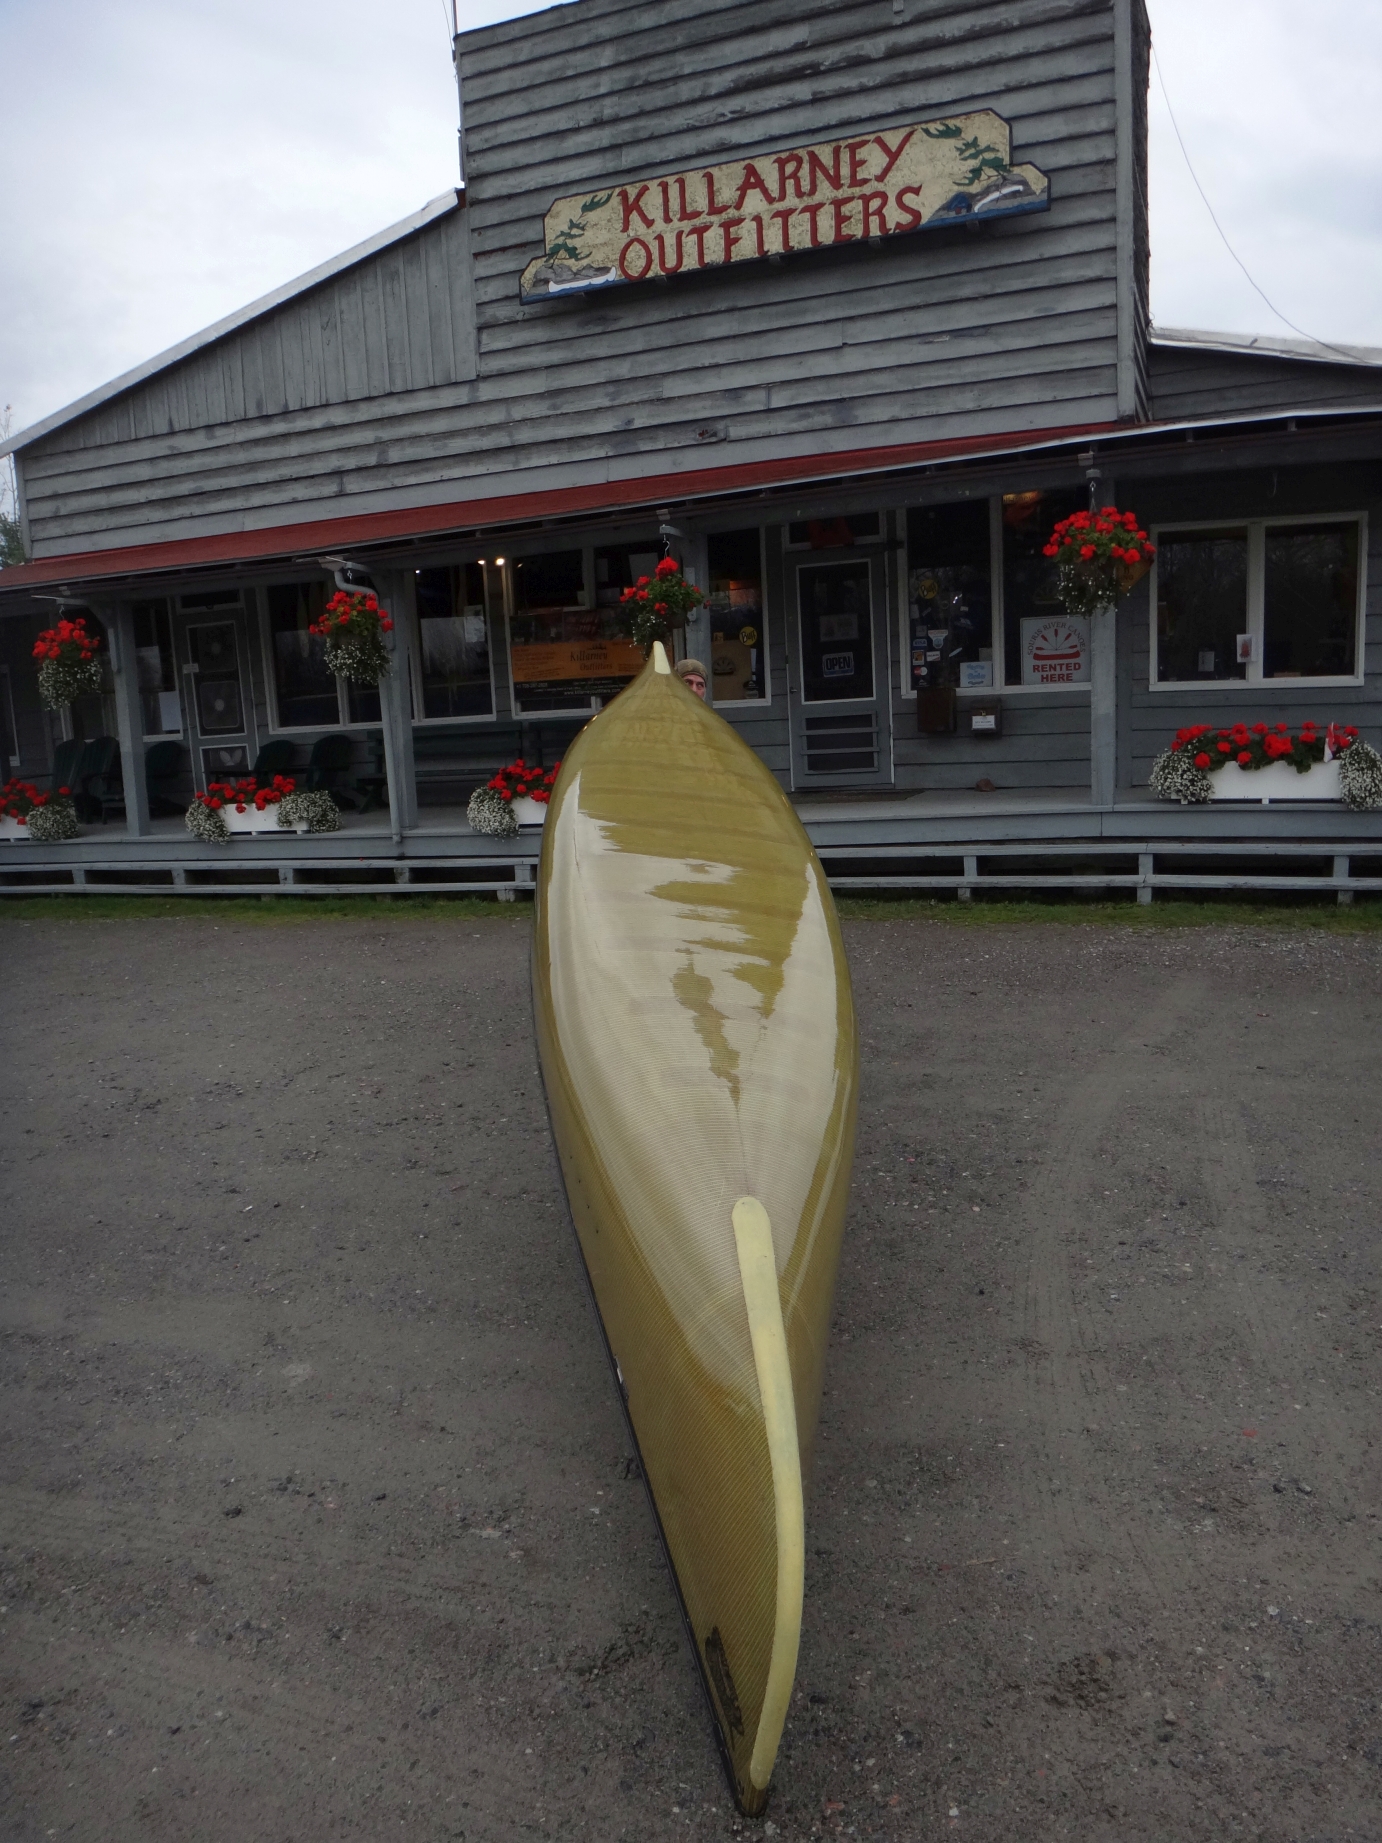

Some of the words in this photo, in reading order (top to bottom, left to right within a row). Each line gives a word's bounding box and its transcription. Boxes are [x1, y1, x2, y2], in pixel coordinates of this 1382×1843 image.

[616, 127, 916, 234] KILLARNEY
[617, 184, 923, 282] OUTFITTERS
[1027, 628, 1043, 656] SOURIS
[1042, 621, 1067, 631] RIVER
[1067, 625, 1086, 653] CANOES
[570, 650, 608, 663] Killarney
[825, 656, 851, 671] OPEN
[1032, 662, 1081, 673] RENTED
[1041, 673, 1073, 683] HERE
